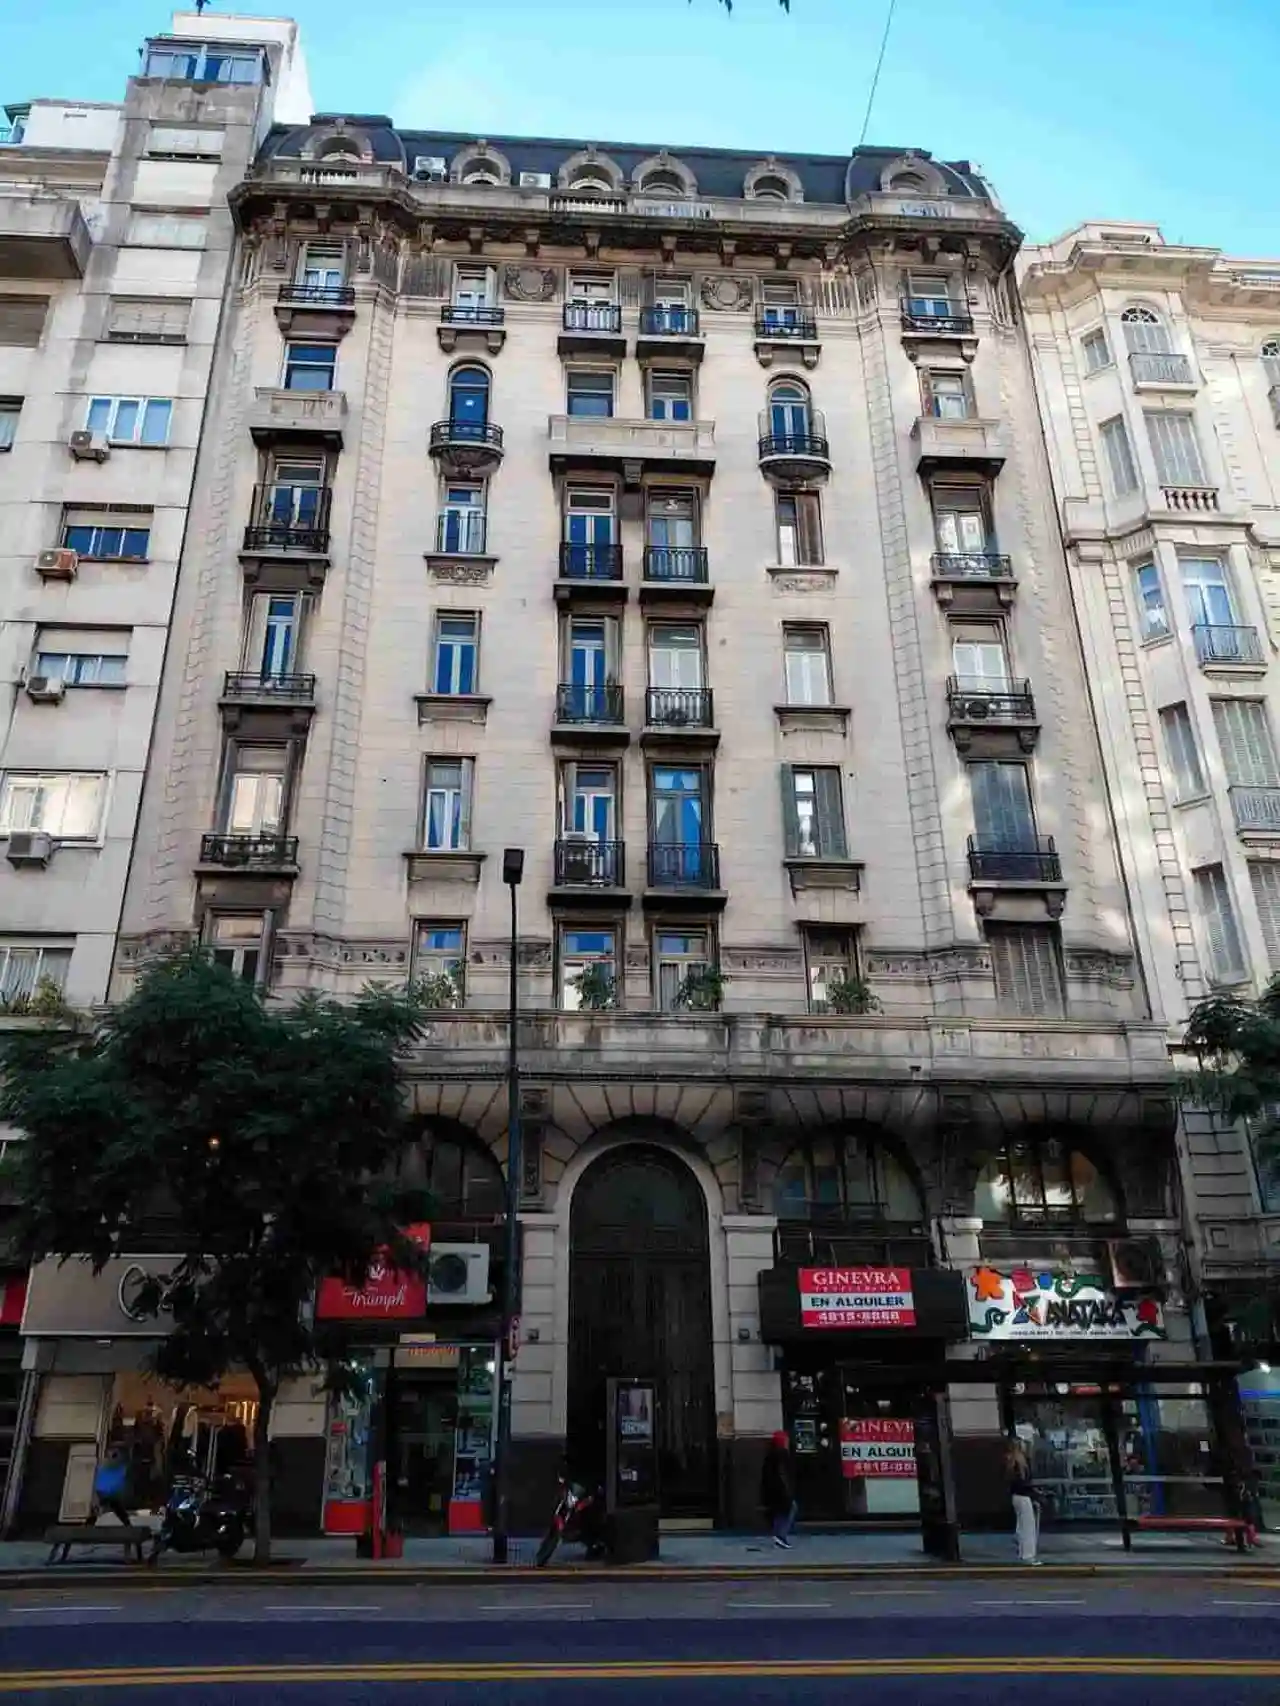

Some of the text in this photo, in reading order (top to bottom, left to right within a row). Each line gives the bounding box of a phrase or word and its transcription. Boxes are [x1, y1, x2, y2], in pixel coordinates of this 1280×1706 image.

[813, 1270, 900, 1285] GINEVRA
[343, 1285, 407, 1312] Triumph
[811, 1296, 905, 1307] EN ALQUILER
[842, 1447, 861, 1457] EN
